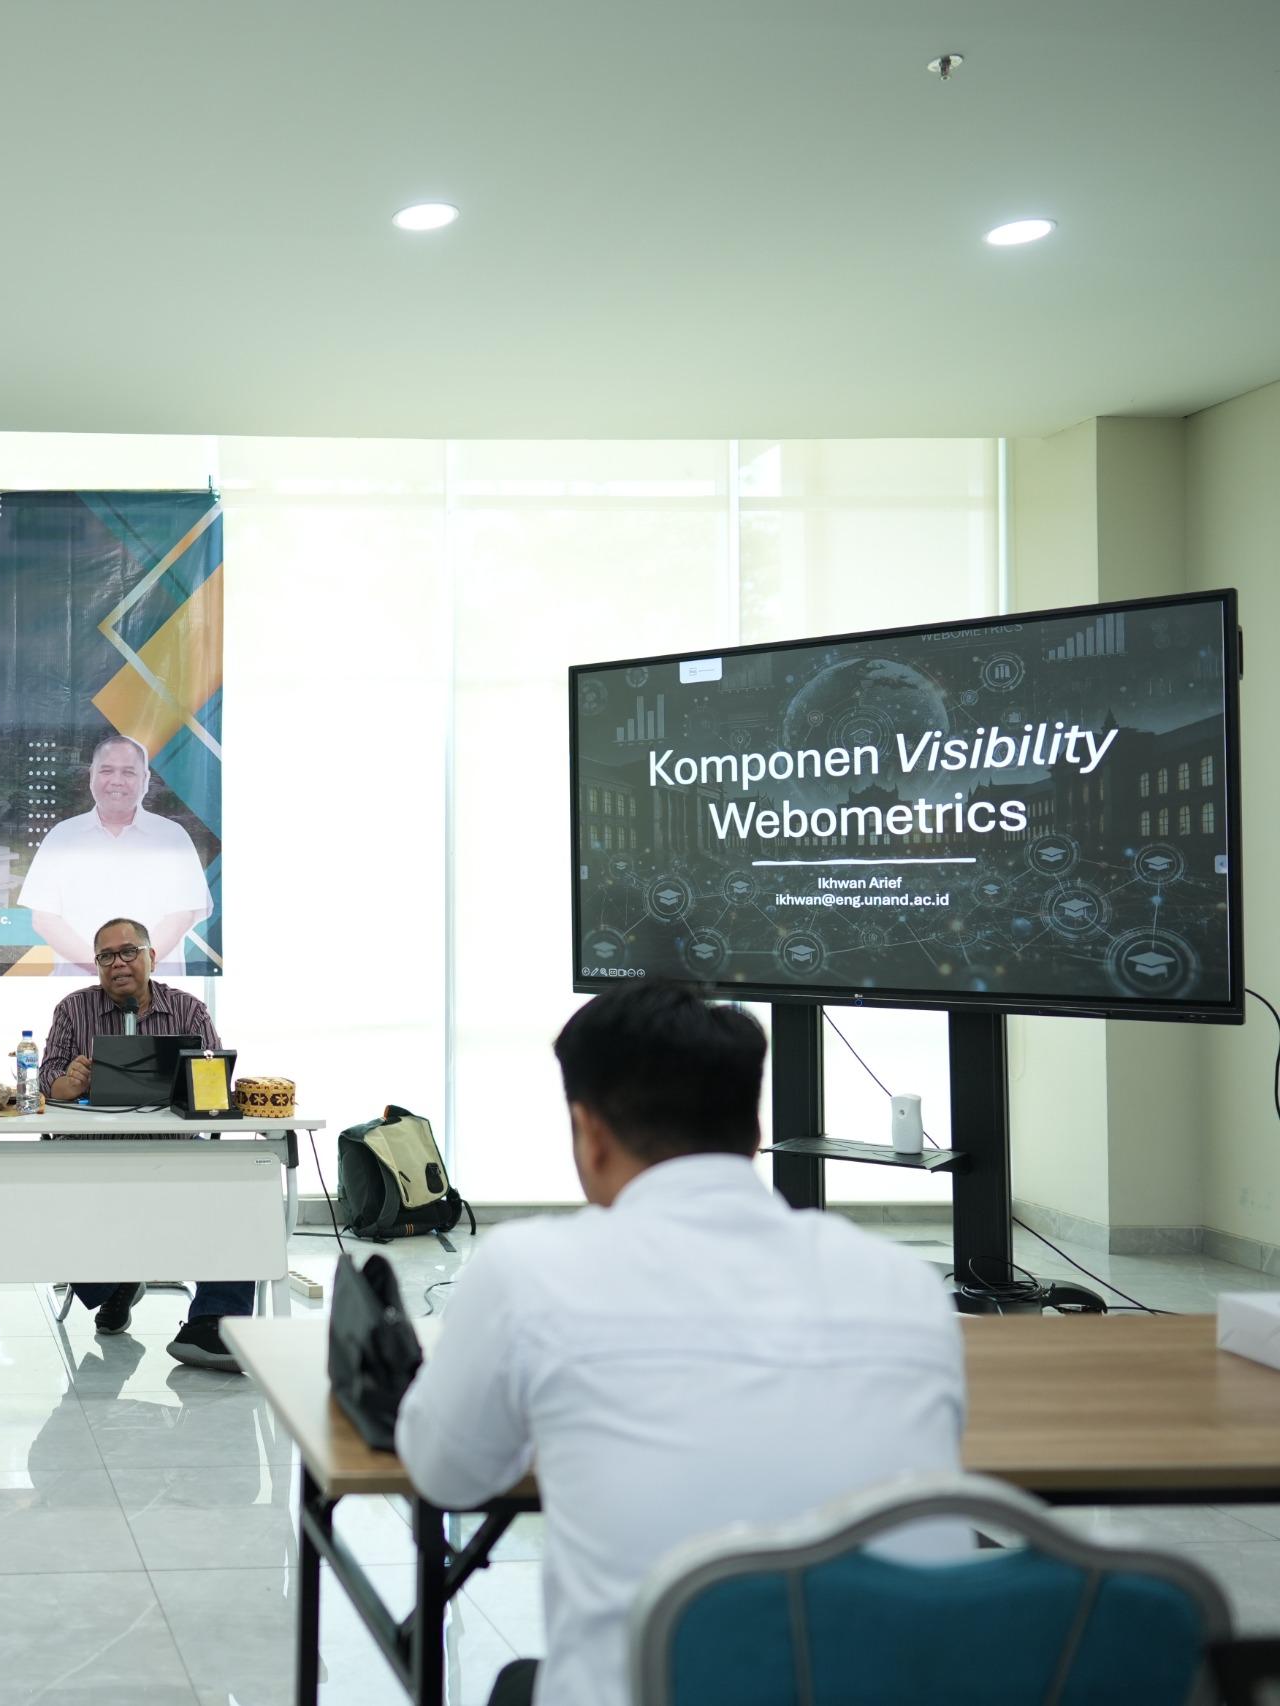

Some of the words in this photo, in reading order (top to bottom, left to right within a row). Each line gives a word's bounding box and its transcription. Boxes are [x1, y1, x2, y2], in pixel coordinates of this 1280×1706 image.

[648, 744, 880, 790] Komponen
[896, 721, 1119, 774] Visibility
[709, 792, 1028, 840] Webometrics
[817, 877, 866, 889] Ikhwan
[869, 876, 903, 889] Arief
[775, 893, 950, 908] ikhwan@eng.unand.ac.id
